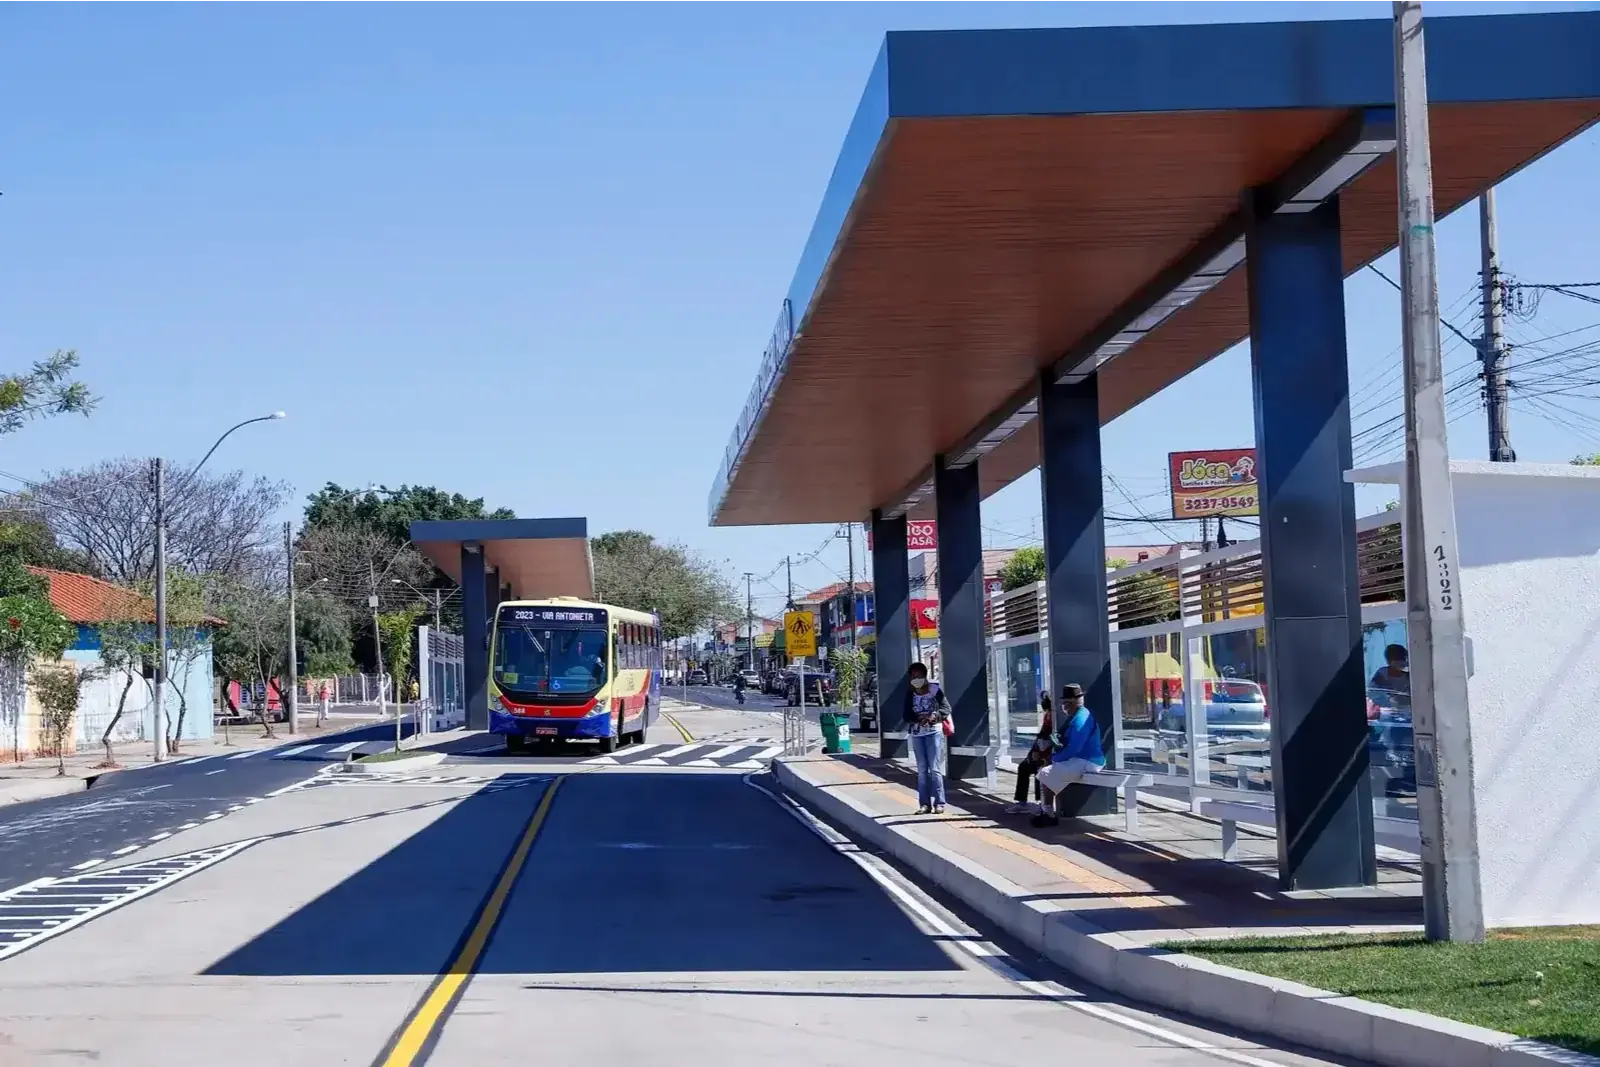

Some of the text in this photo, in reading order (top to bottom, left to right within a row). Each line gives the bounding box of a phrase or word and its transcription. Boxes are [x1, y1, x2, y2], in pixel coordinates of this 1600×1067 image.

[1184, 496, 1255, 510] 3237-0549
[515, 610, 534, 620] 2023
[555, 611, 594, 621] ANTONIETA
